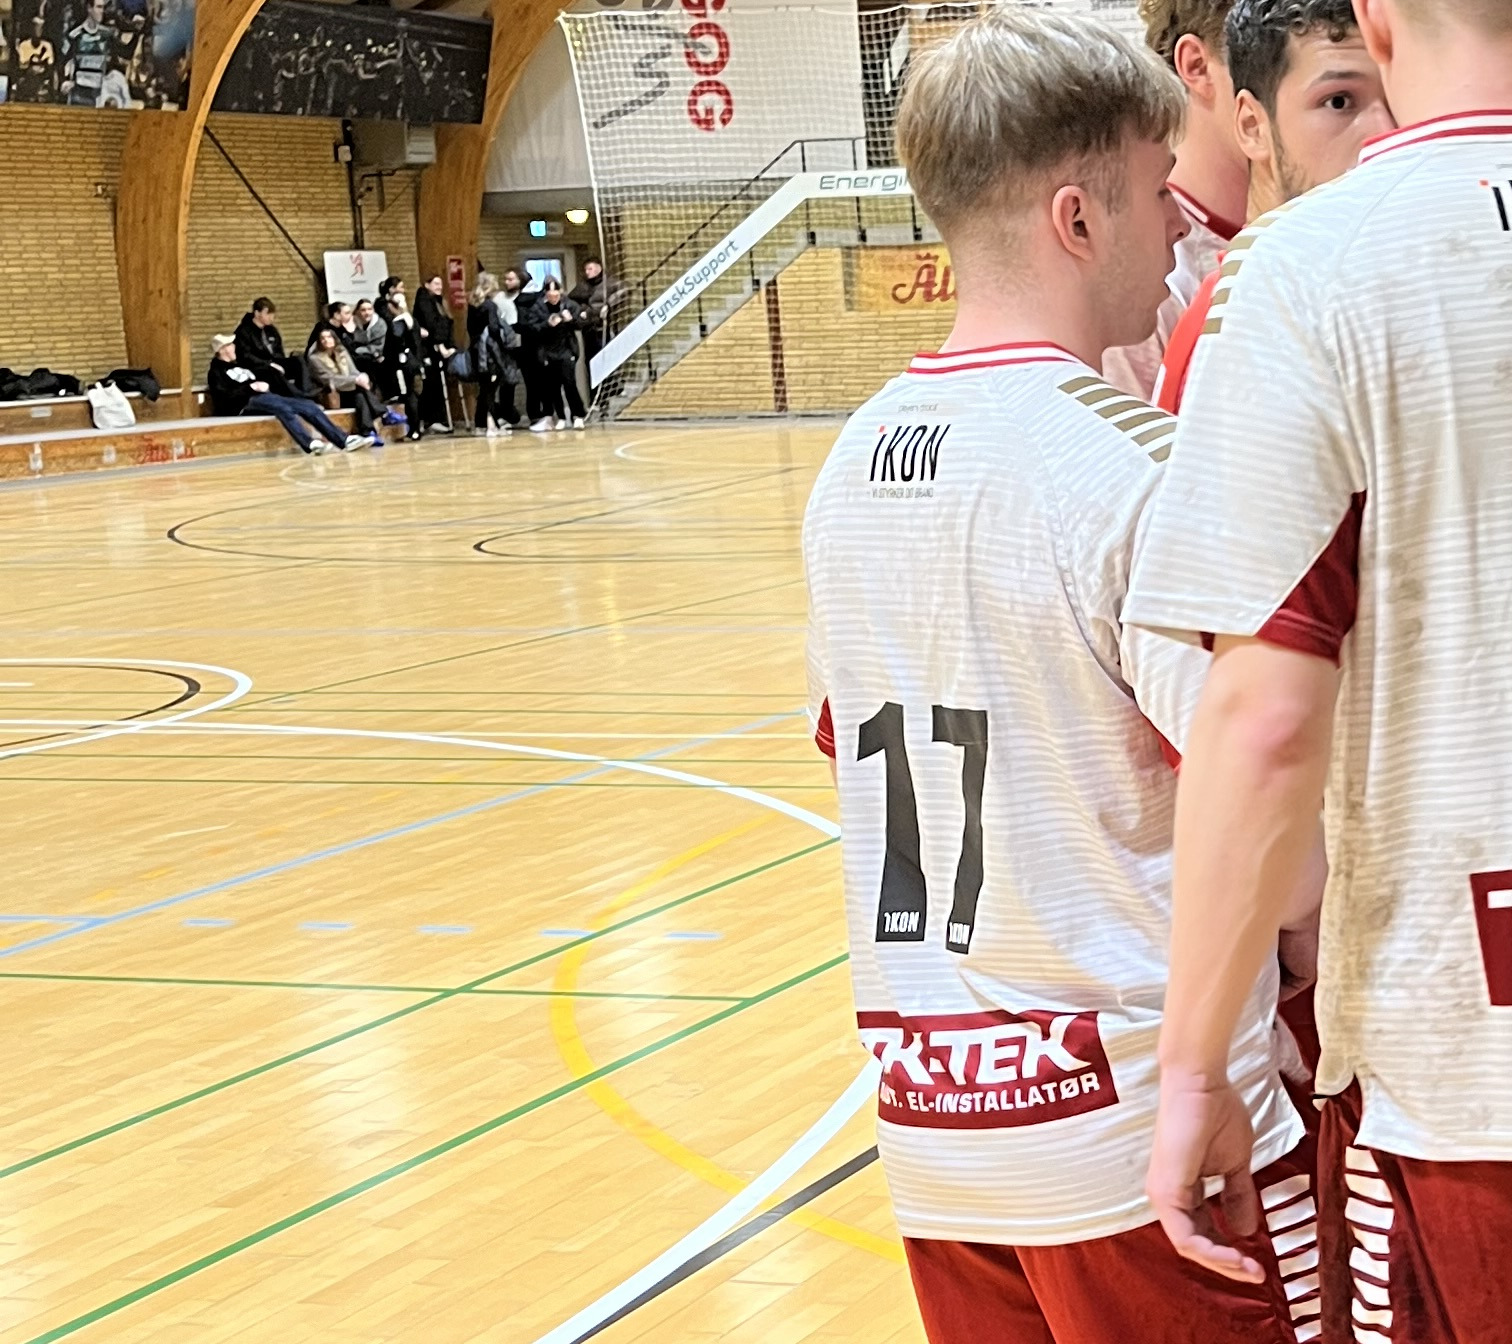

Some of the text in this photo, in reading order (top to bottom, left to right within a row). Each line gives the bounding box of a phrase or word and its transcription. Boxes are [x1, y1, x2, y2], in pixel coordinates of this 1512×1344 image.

[647, 239, 739, 326] FynskSupport
[856, 701, 988, 954] 17
[905, 1071, 1101, 1114] EL-INSTALLATØR
